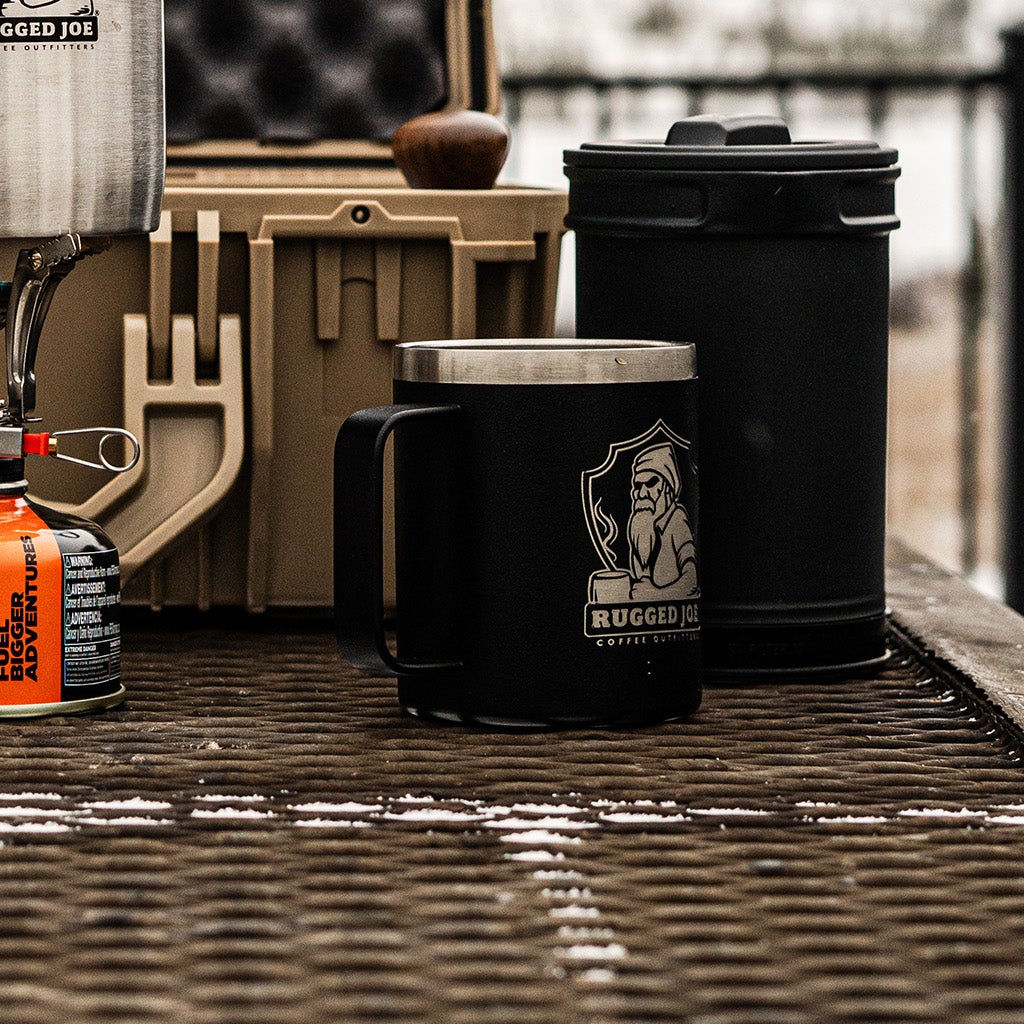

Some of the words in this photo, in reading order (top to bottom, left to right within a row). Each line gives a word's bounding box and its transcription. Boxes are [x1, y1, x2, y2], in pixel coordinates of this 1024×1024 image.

[59, 20, 93, 40] JOE
[20, 535, 38, 683] ADVENTURES
[591, 605, 678, 629] RUGGED
[680, 603, 699, 628] JOE
[10, 592, 24, 682] BIGGER
[596, 637, 646, 646] COFFEE
